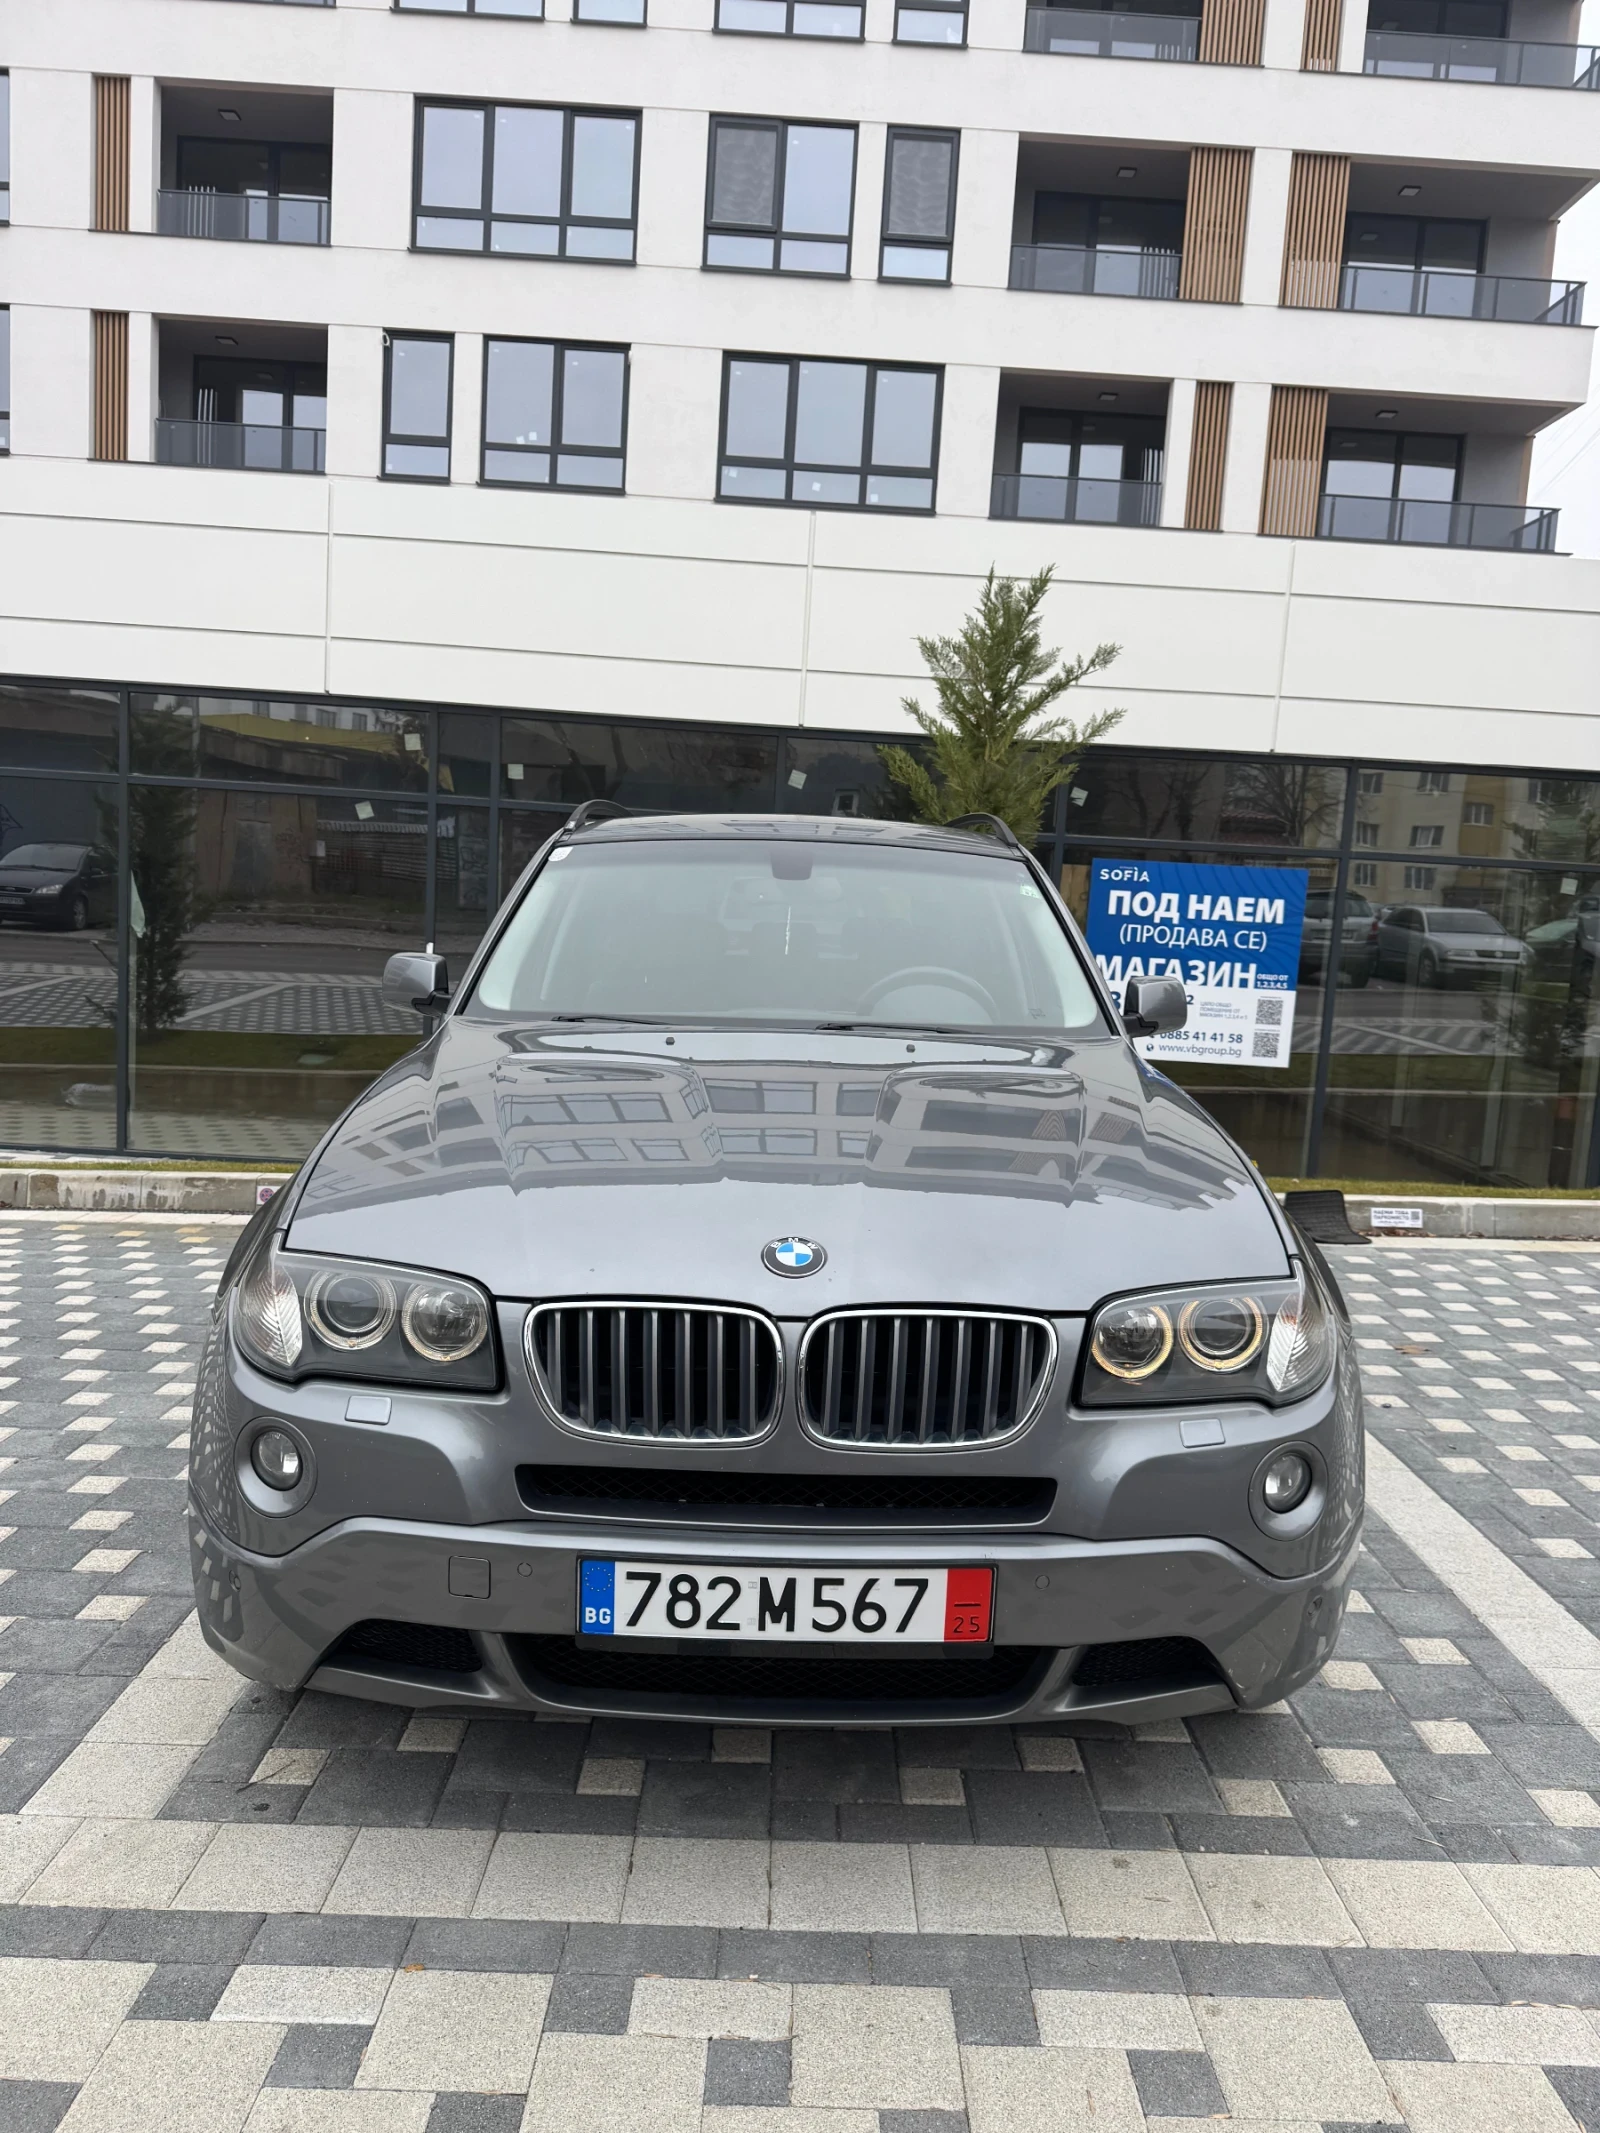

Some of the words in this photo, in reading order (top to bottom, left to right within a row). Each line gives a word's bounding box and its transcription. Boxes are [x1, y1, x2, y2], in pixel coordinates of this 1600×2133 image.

[1108, 890, 1180, 925] ПОД
[1187, 894, 1285, 925] НАЕМ
[1119, 923, 1229, 949] (ПРОДАВА
[1234, 930, 1268, 953] СЕ)
[1096, 953, 1258, 989] МАГАЗИН
[1160, 1030, 1189, 1040] 0885
[1192, 1031, 1206, 1041] 41
[1210, 1032, 1224, 1042] 41
[1228, 1033, 1243, 1044] 58
[1158, 1043, 1242, 1058] www.vbgroup.bg
[770, 1237, 818, 1249] BMW
[585, 1607, 611, 1624] BG
[953, 1615, 980, 1633] 25
